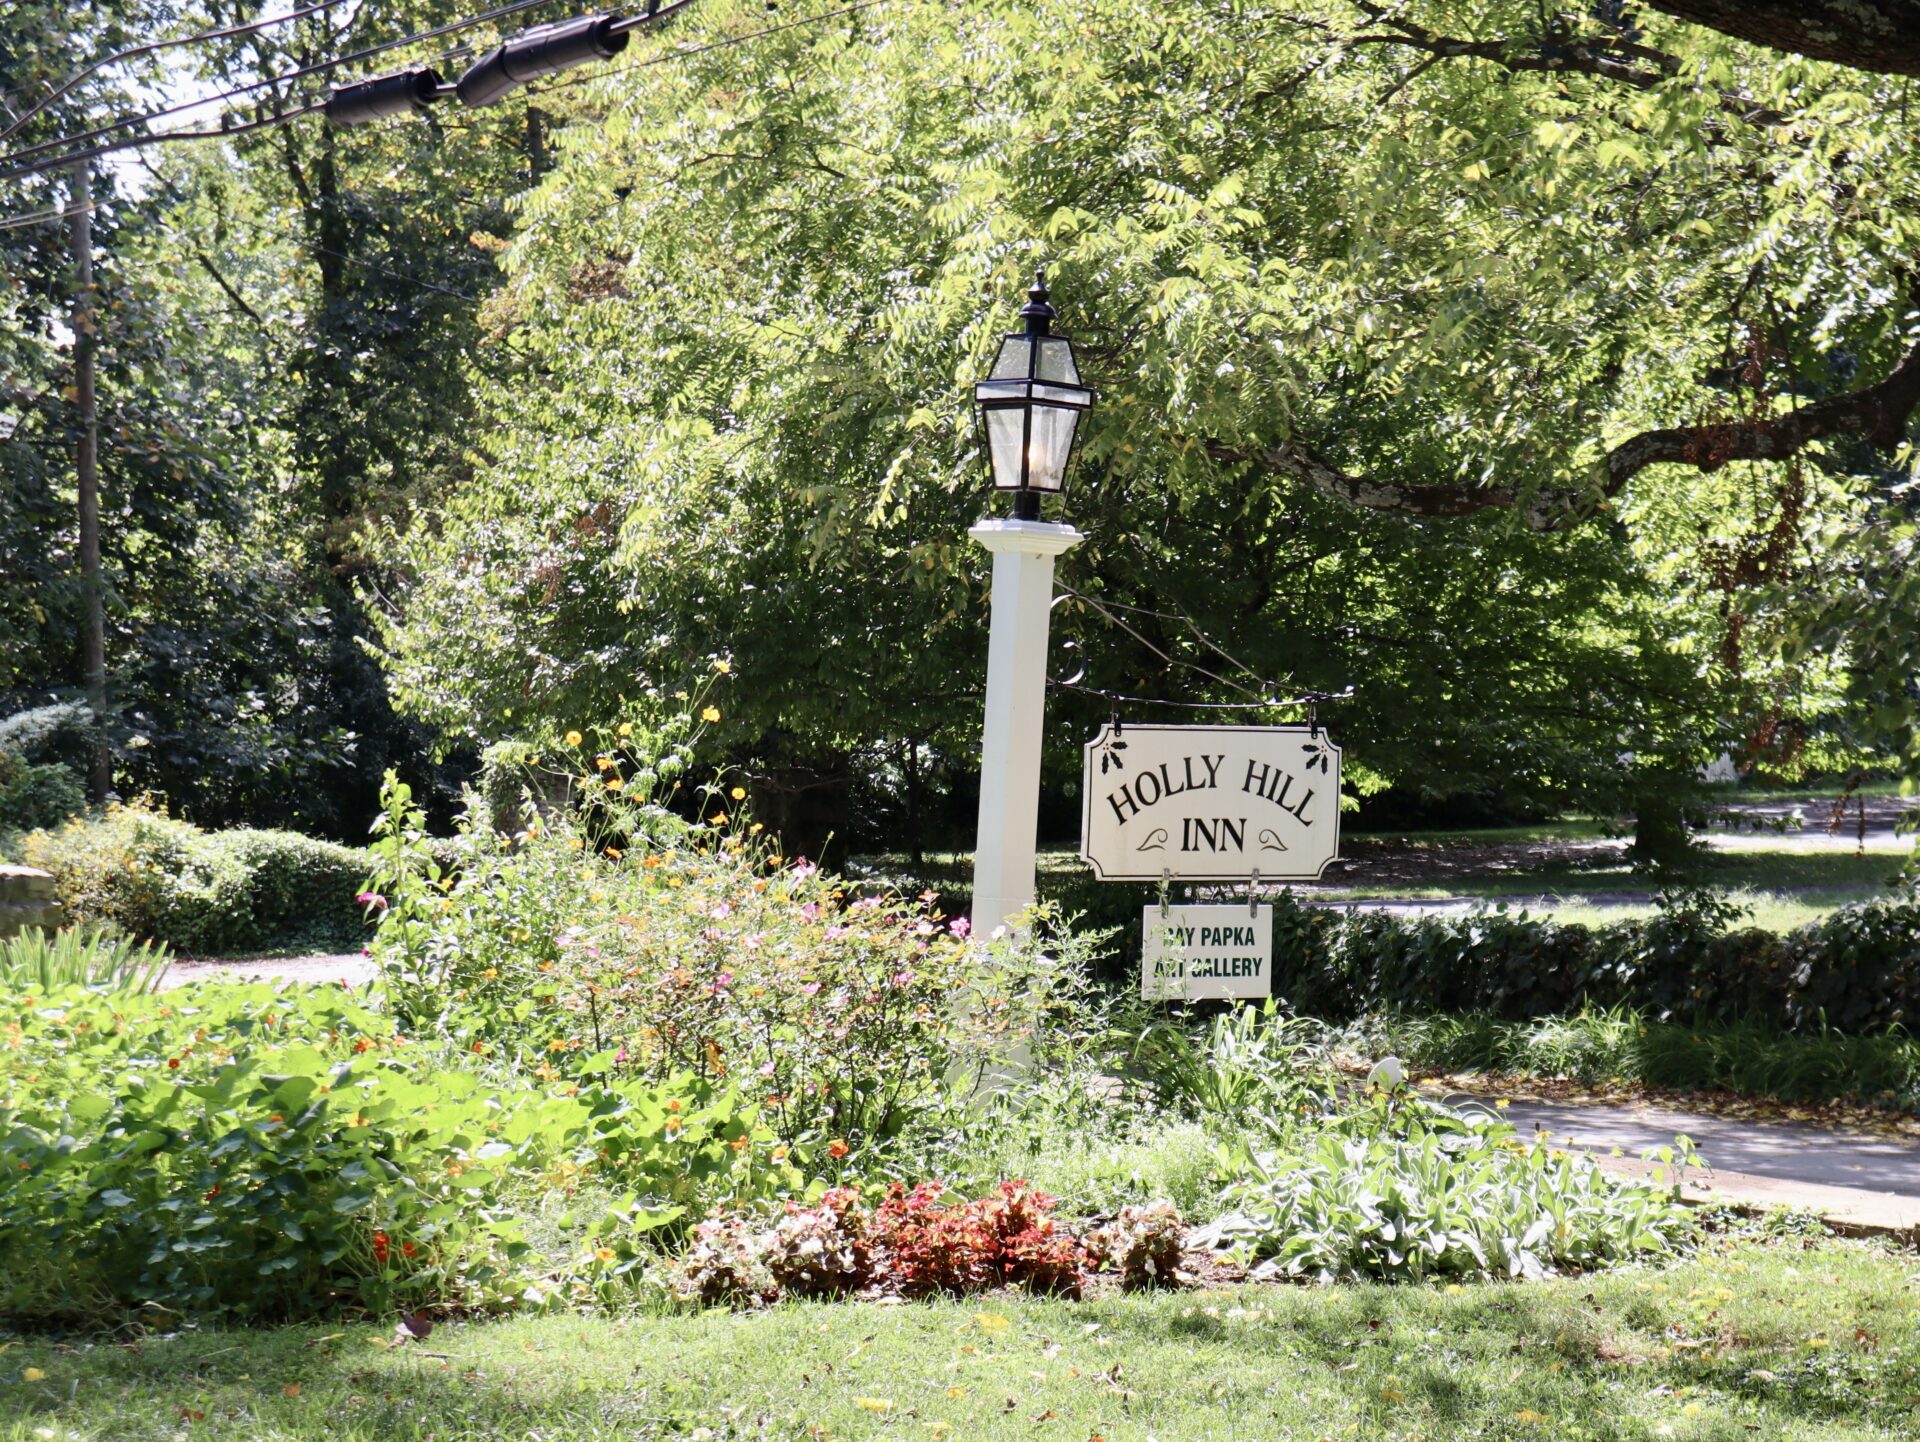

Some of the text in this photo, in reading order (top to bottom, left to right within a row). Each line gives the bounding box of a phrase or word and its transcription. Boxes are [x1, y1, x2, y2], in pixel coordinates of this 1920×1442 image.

[1107, 755, 1315, 827] HOLLY HILL
[1180, 818, 1247, 854] INN
[1201, 927, 1255, 946] PAPKA
[1192, 957, 1262, 978] GALLERY
